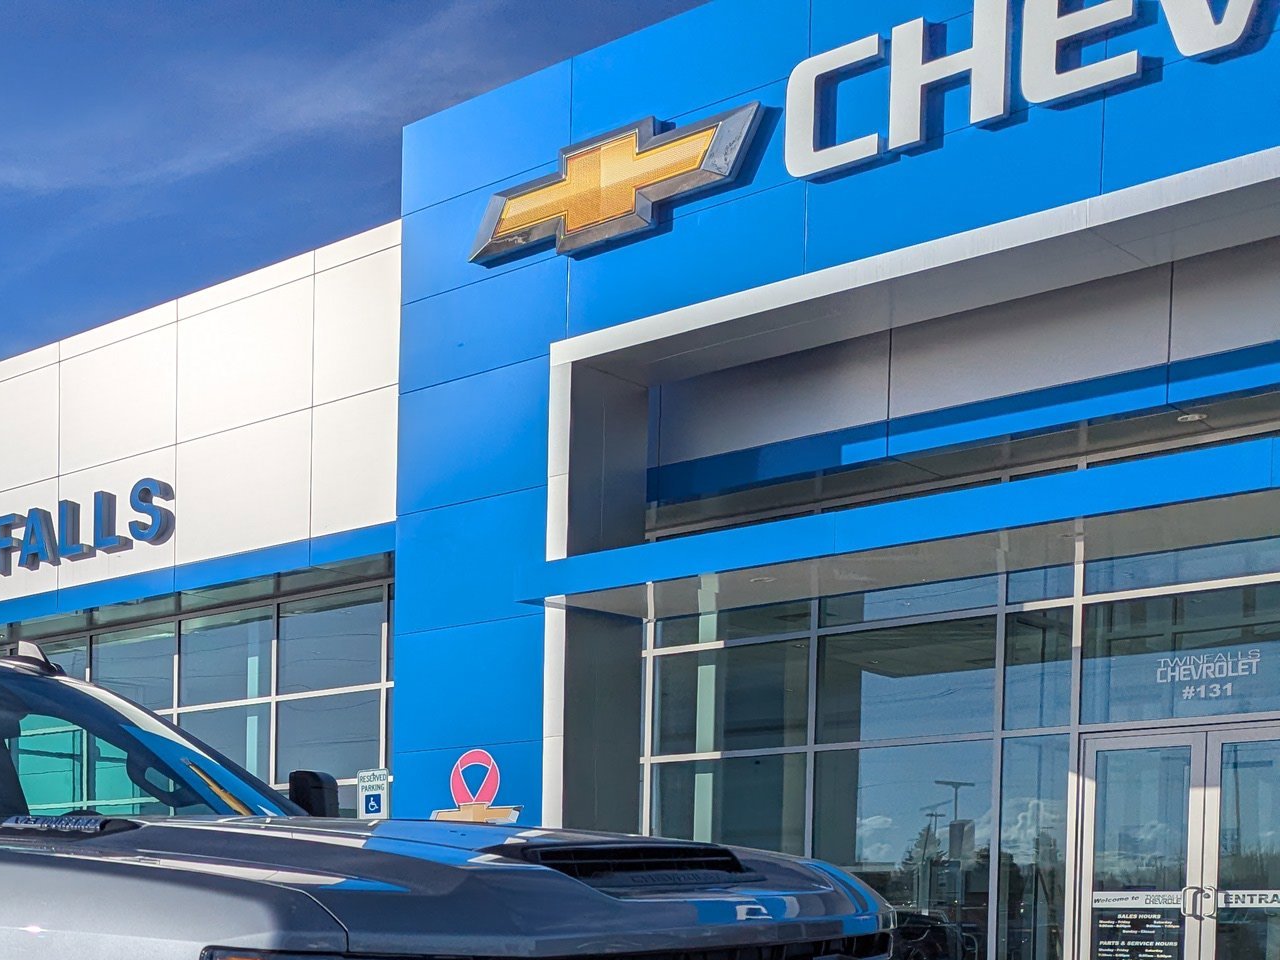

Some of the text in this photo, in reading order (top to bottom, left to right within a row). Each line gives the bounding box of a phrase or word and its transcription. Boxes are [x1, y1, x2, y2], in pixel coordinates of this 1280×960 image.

[1156, 659, 1261, 683] CHEVROLET
[1182, 683, 1233, 699] #131
[359, 774, 387, 783] RESERVED
[361, 784, 385, 792] PARKING
[1093, 896, 1130, 904] Welcome
[1223, 894, 1280, 904] ENTRA
